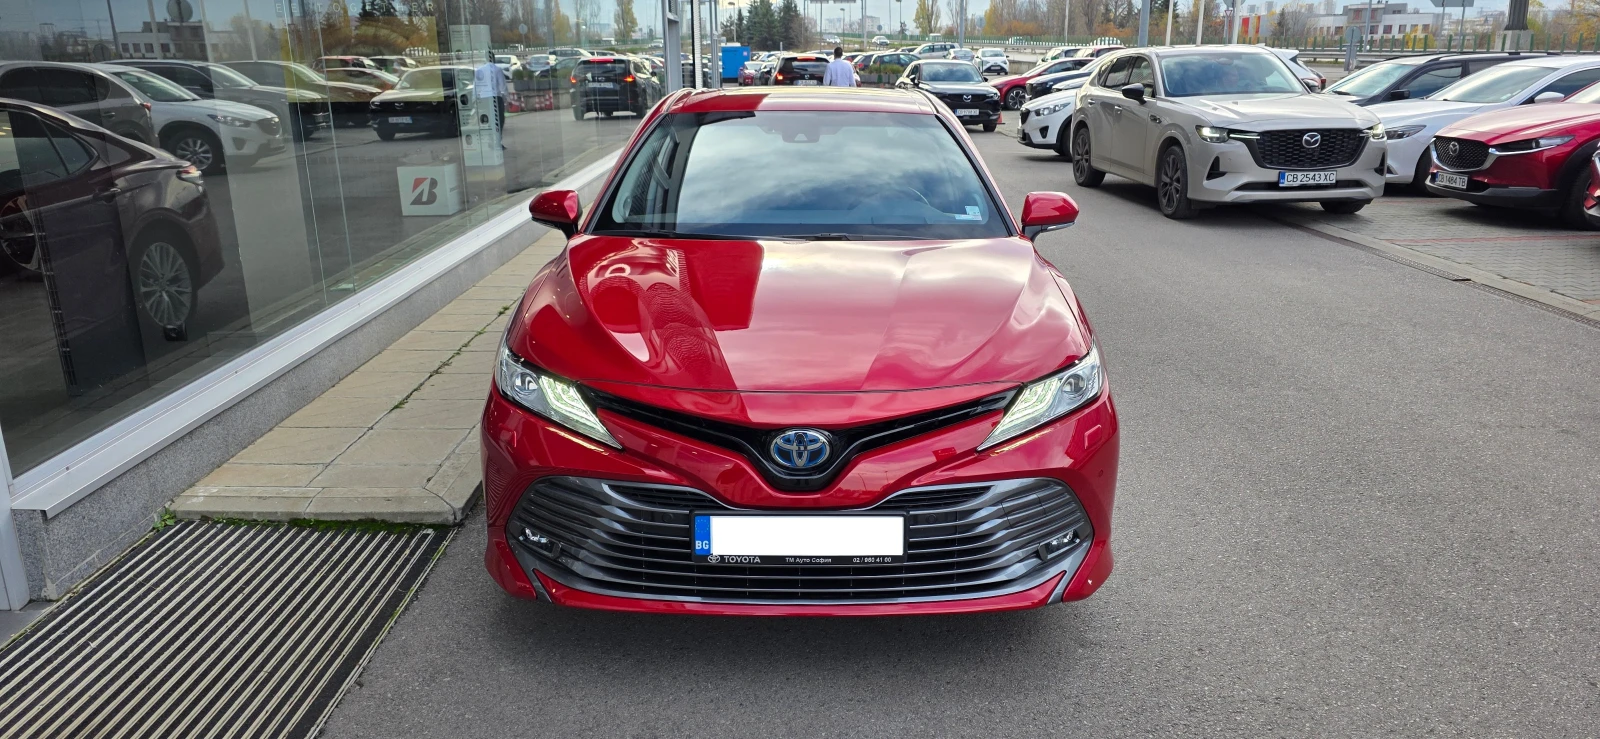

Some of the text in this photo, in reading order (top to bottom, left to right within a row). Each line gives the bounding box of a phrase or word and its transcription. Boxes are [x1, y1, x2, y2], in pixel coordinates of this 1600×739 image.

[317, 3, 434, 12] TOGETHER
[1286, 172, 1335, 183] CB 2543 XC
[695, 540, 709, 550] BG
[723, 555, 761, 563] TOYOTA
